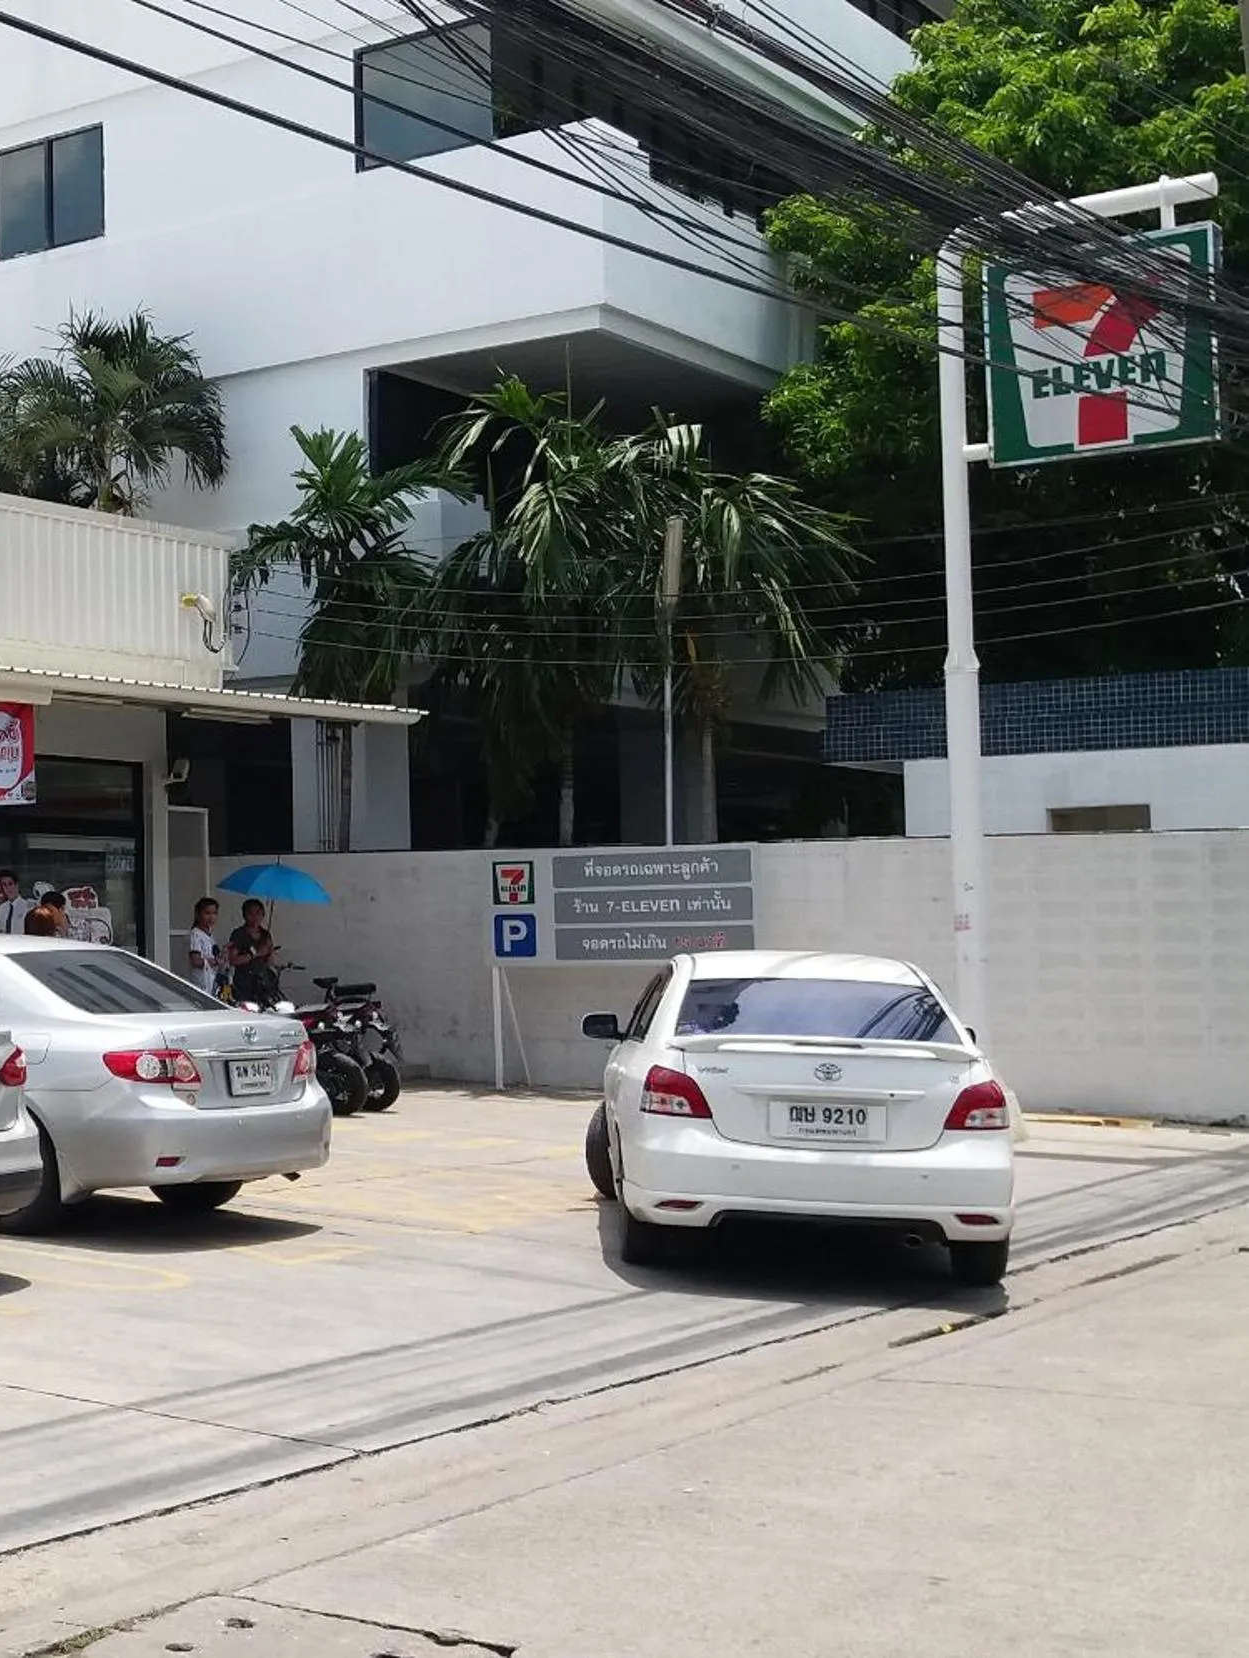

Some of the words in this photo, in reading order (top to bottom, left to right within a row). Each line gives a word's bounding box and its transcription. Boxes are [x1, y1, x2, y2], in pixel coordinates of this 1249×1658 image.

[1032, 274, 1164, 445] 7
[584, 857, 718, 880] ที่จอดรถเฉพาะลูกค้า
[573, 898, 598, 913] ร้าน
[687, 890, 732, 911] เท่านั้น
[502, 919, 527, 952] P
[582, 932, 666, 949] จอดรถไม่เกิน
[822, 1107, 867, 1125] 9210
